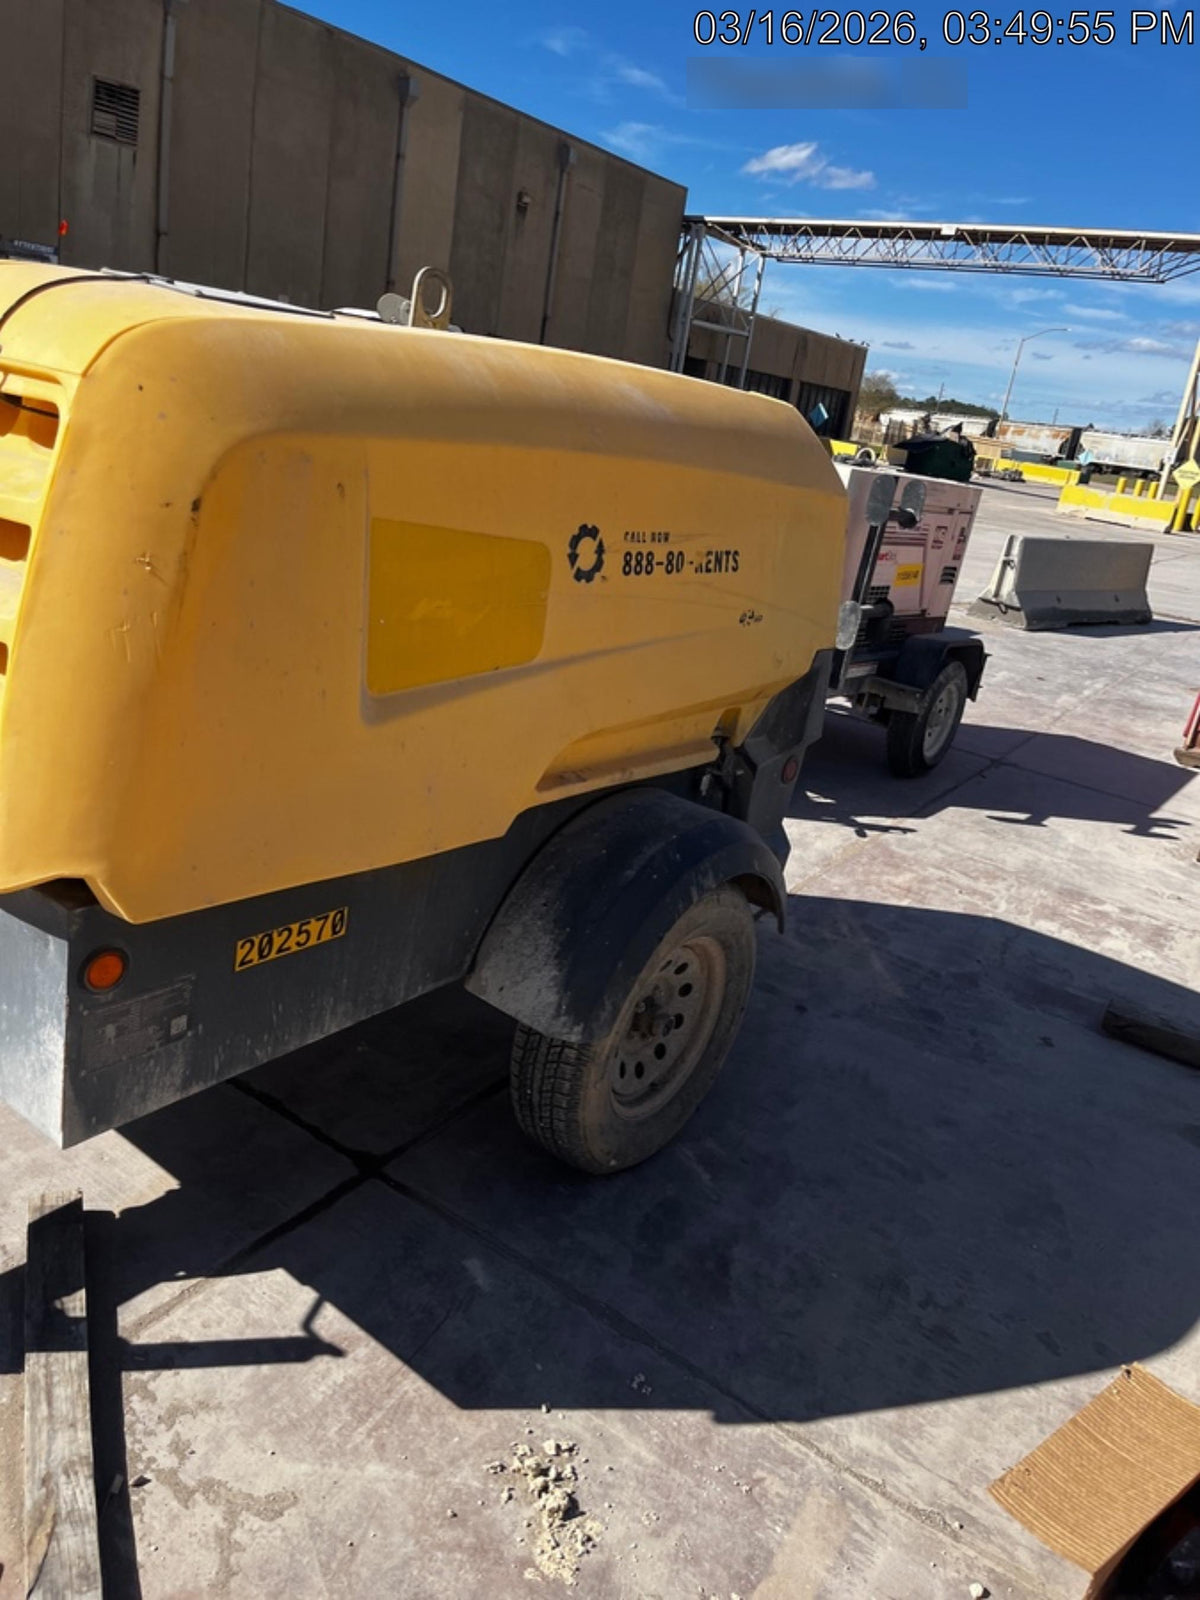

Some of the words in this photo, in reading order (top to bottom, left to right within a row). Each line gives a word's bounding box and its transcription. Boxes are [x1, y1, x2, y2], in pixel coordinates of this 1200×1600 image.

[623, 531, 646, 543] CALL
[651, 531, 670, 543] NOW
[238, 910, 345, 967] 202570
